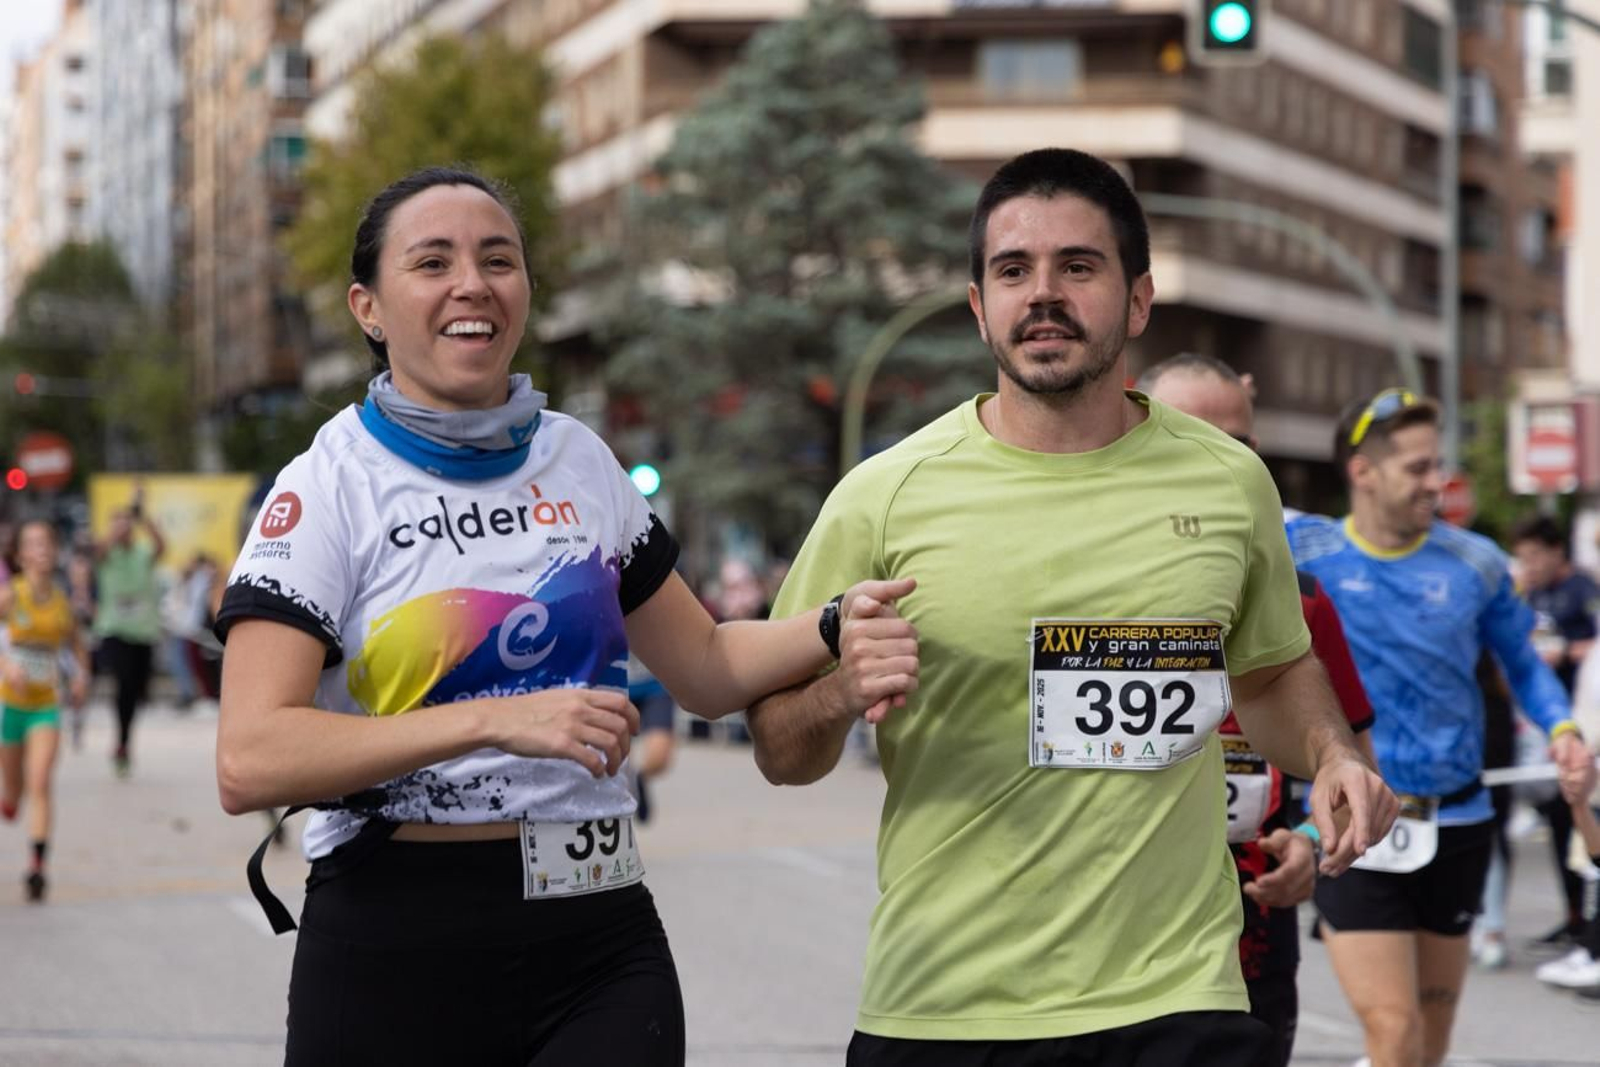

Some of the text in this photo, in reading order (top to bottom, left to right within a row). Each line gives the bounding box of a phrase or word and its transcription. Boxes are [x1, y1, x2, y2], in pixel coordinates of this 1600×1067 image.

[1041, 627, 1085, 652] XXV
[1089, 628, 1219, 639] CARRERA POPULAR
[1088, 639, 1221, 653] y gran caminata
[1061, 657, 1083, 667] POR
[1085, 657, 1101, 668] LA
[1136, 657, 1152, 668] LA
[1075, 680, 1195, 736] 392
